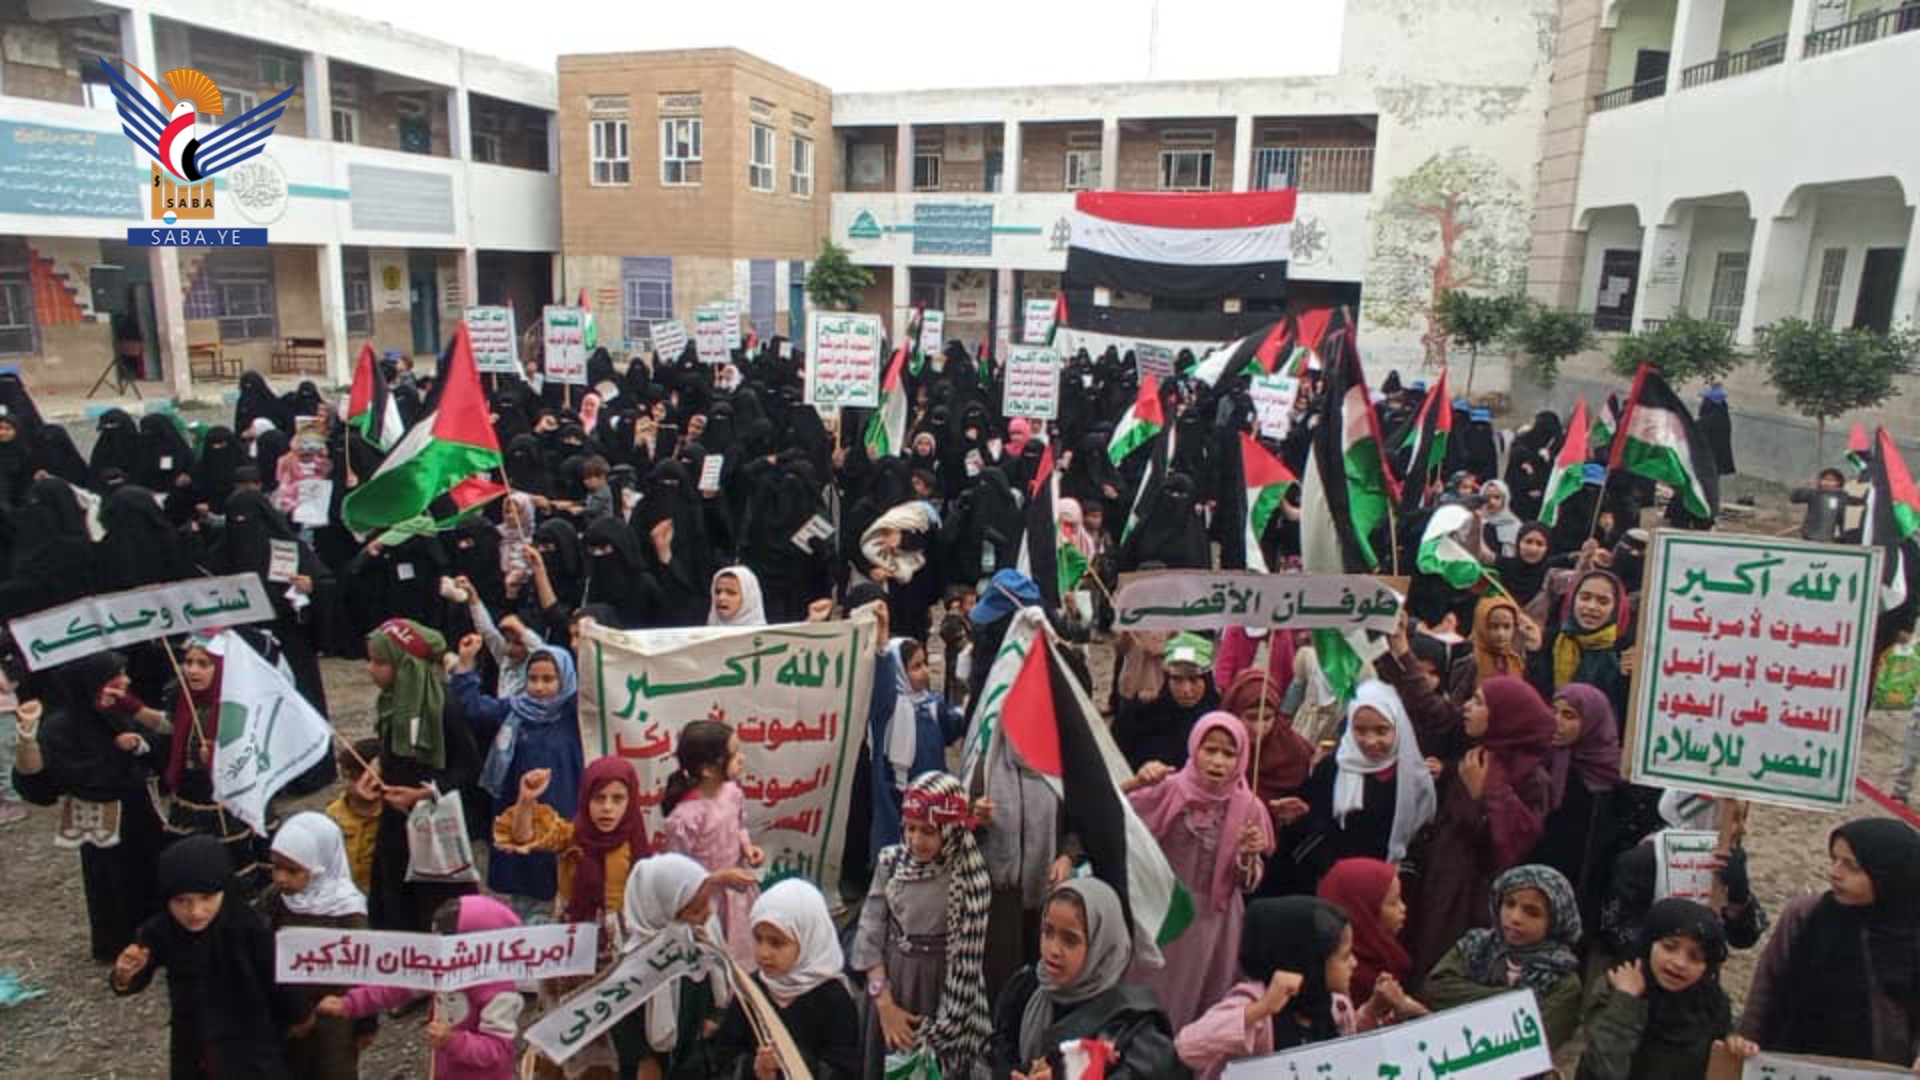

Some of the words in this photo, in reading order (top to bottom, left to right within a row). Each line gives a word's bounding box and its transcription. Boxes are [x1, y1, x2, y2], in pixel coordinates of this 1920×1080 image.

[1669, 552, 1786, 603] أكبر
[1787, 562, 1858, 604] الله
[182, 588, 251, 624] لستم
[1120, 580, 1260, 625] الأقصى
[1271, 587, 1400, 623] طوفان
[29, 606, 174, 661] وحدكم
[1770, 620, 1852, 649] الموت
[612, 635, 790, 722] أكبر
[776, 648, 844, 688] الله
[1765, 662, 1847, 691] الموت
[1657, 692, 1725, 723] اليهود
[1730, 698, 1769, 726] على
[1779, 700, 1842, 734] اللعنة
[737, 713, 838, 751] الموت
[1653, 726, 1745, 776] للإسلام
[1750, 740, 1837, 780] النصر
[289, 935, 370, 973] الأكبر
[376, 941, 492, 979] الشيطان
[497, 925, 577, 968] أمريكا
